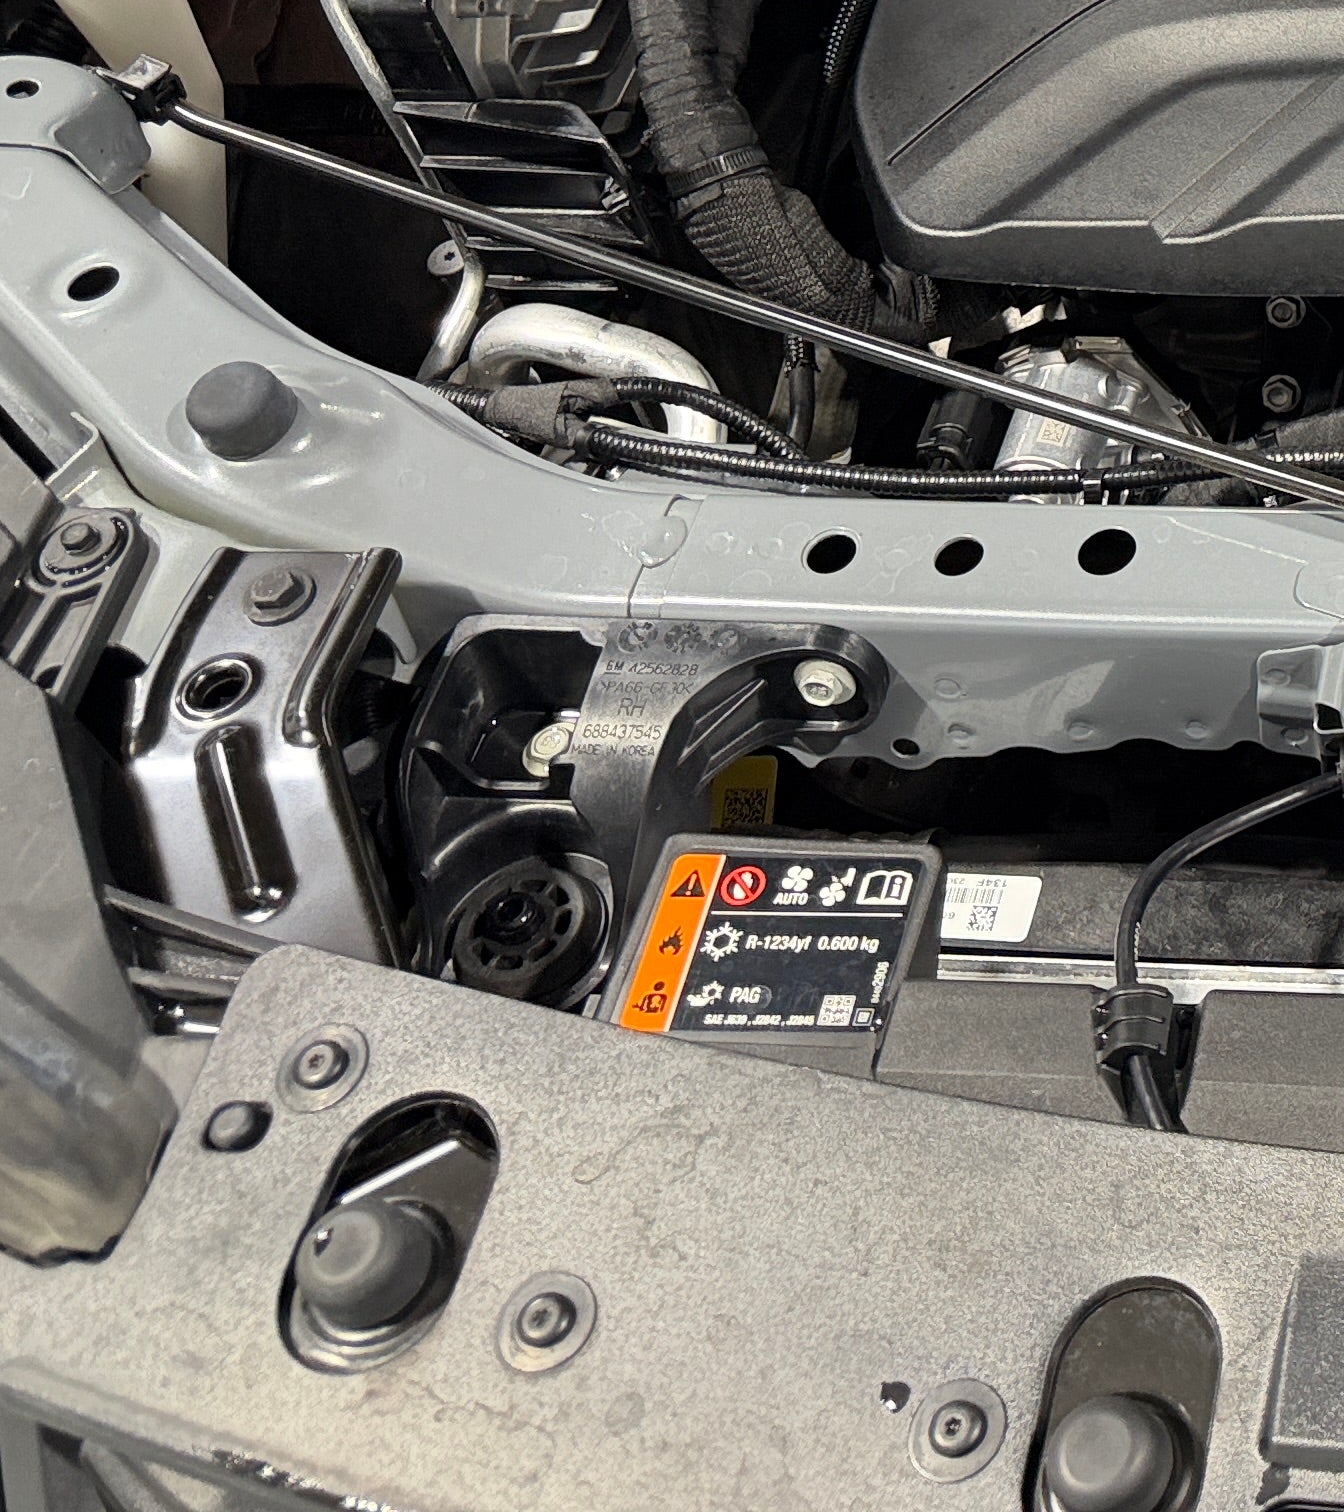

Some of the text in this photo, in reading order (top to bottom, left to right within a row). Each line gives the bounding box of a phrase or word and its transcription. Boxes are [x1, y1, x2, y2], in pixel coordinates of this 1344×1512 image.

[617, 697, 648, 718] RH
[571, 744, 656, 757] MADE IN KOREA
[773, 892, 809, 906] AUTO
[745, 934, 880, 954] R-1234yf 0.600 kg
[729, 987, 762, 1005] PAG
[703, 1013, 725, 1026] SAE
